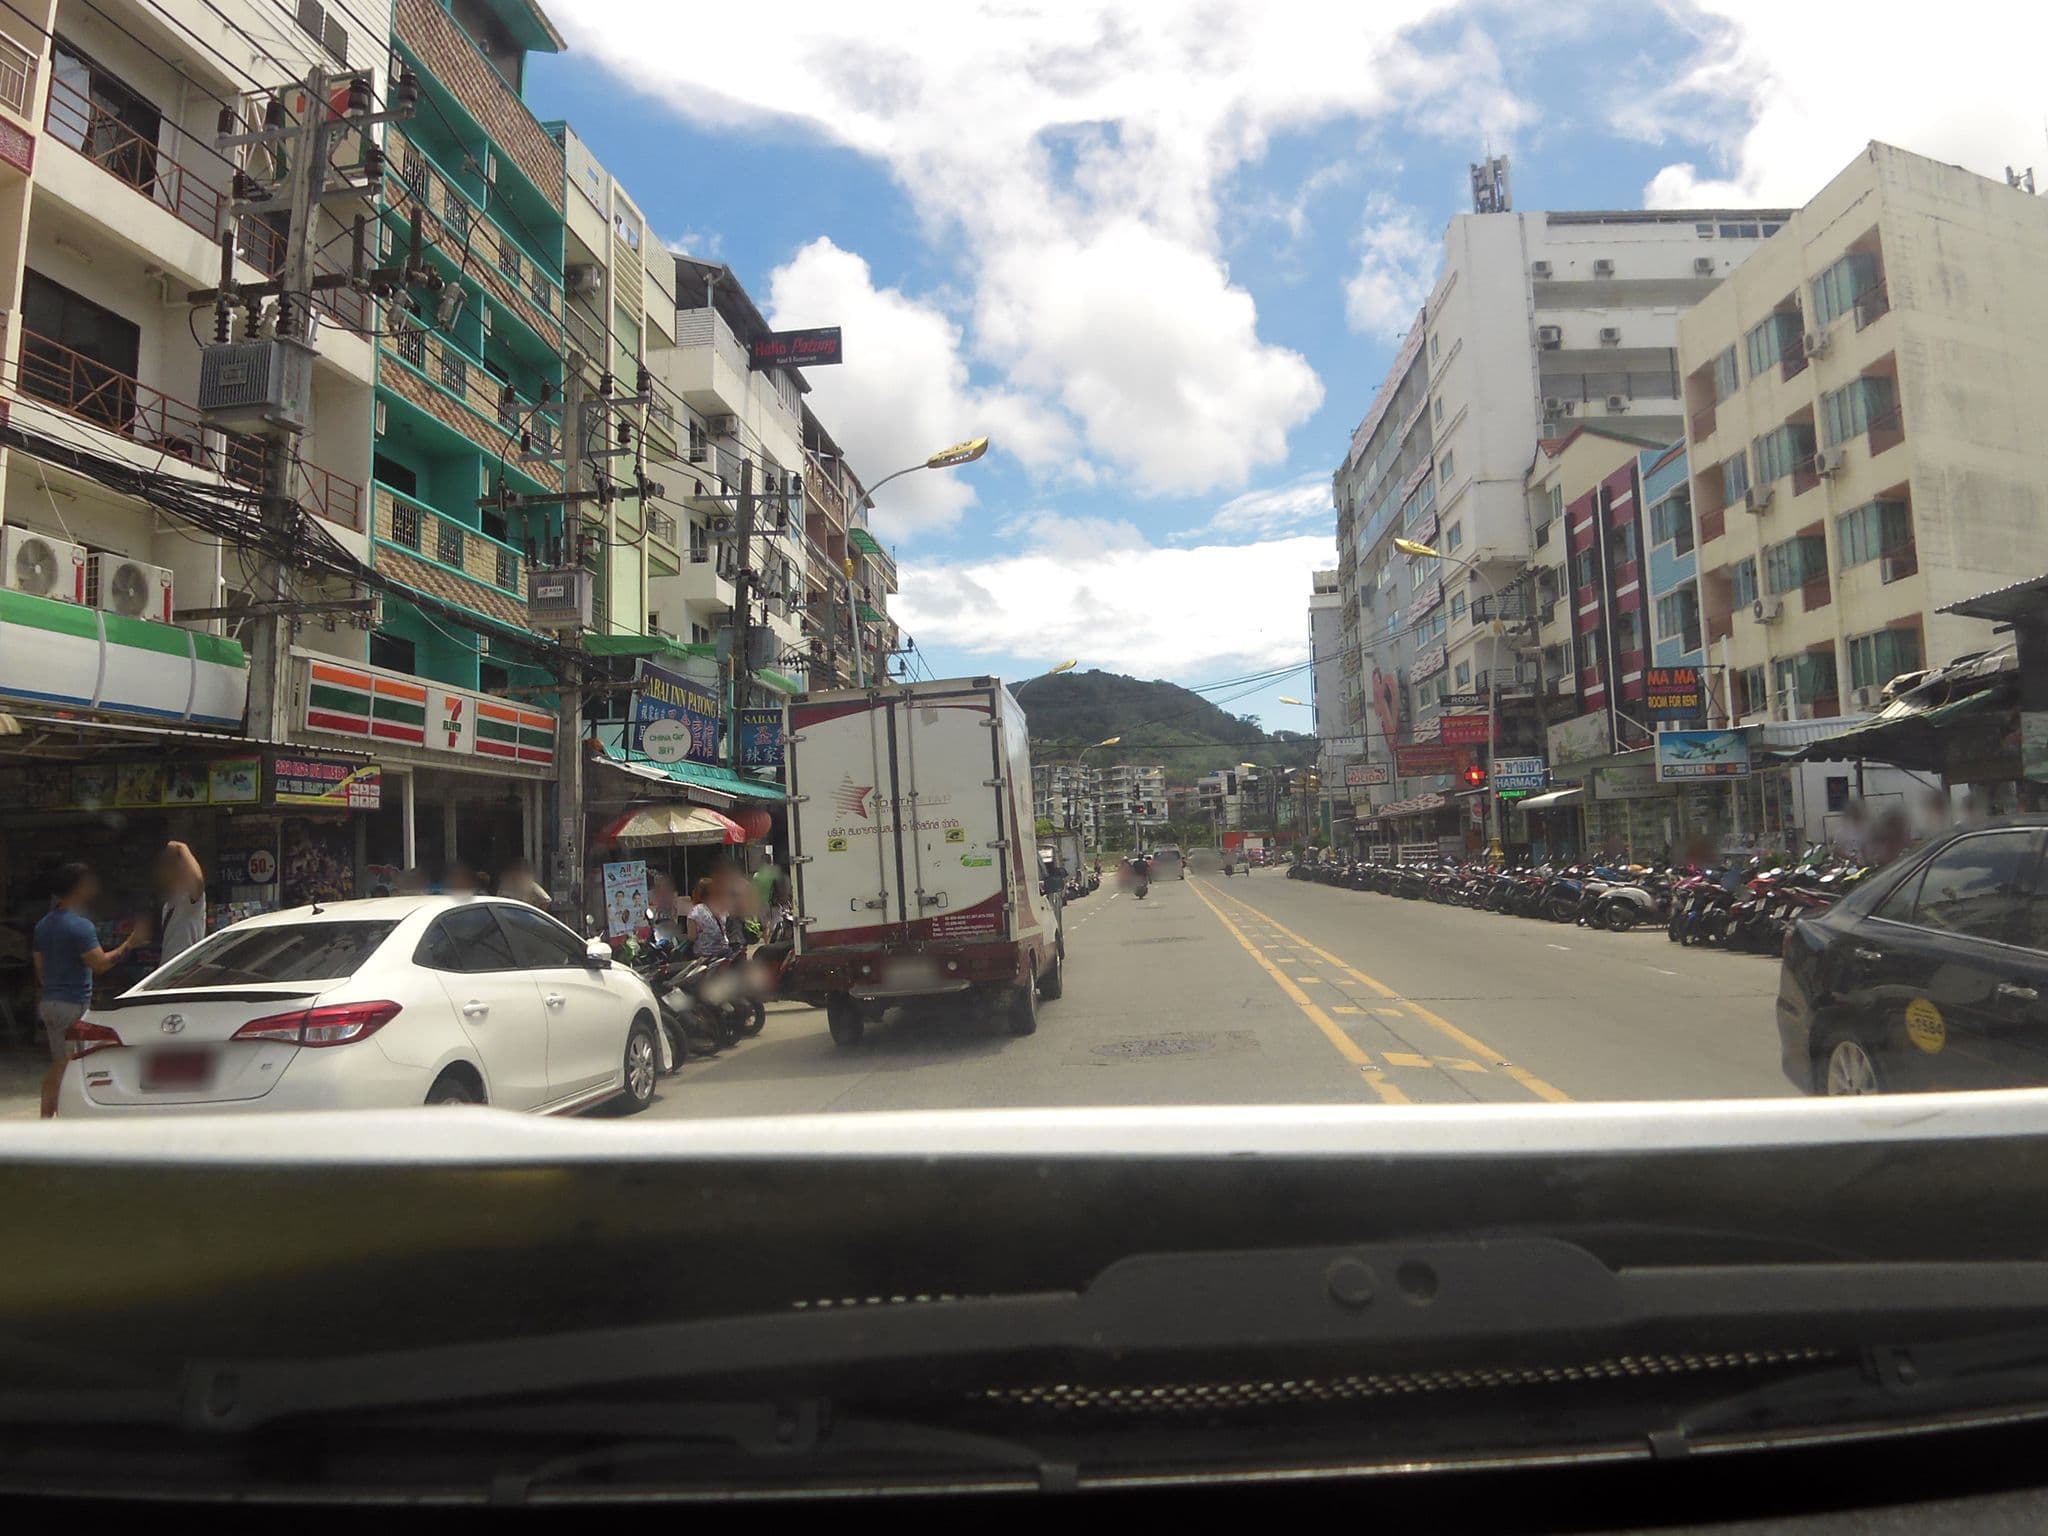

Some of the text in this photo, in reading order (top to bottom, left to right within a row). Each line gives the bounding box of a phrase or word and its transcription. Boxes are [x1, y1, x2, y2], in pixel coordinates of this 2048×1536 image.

[1647, 669, 1697, 686] MA MA
[670, 685, 687, 709] INN
[687, 691, 717, 719] PATONG
[1450, 695, 1480, 704] ROOM
[1647, 694, 1698, 709] ROOM FOR RENT
[743, 714, 778, 724] SABAI
[1347, 773, 1386, 783] HOLIDAY
[1495, 776, 1545, 789] HARMACY
